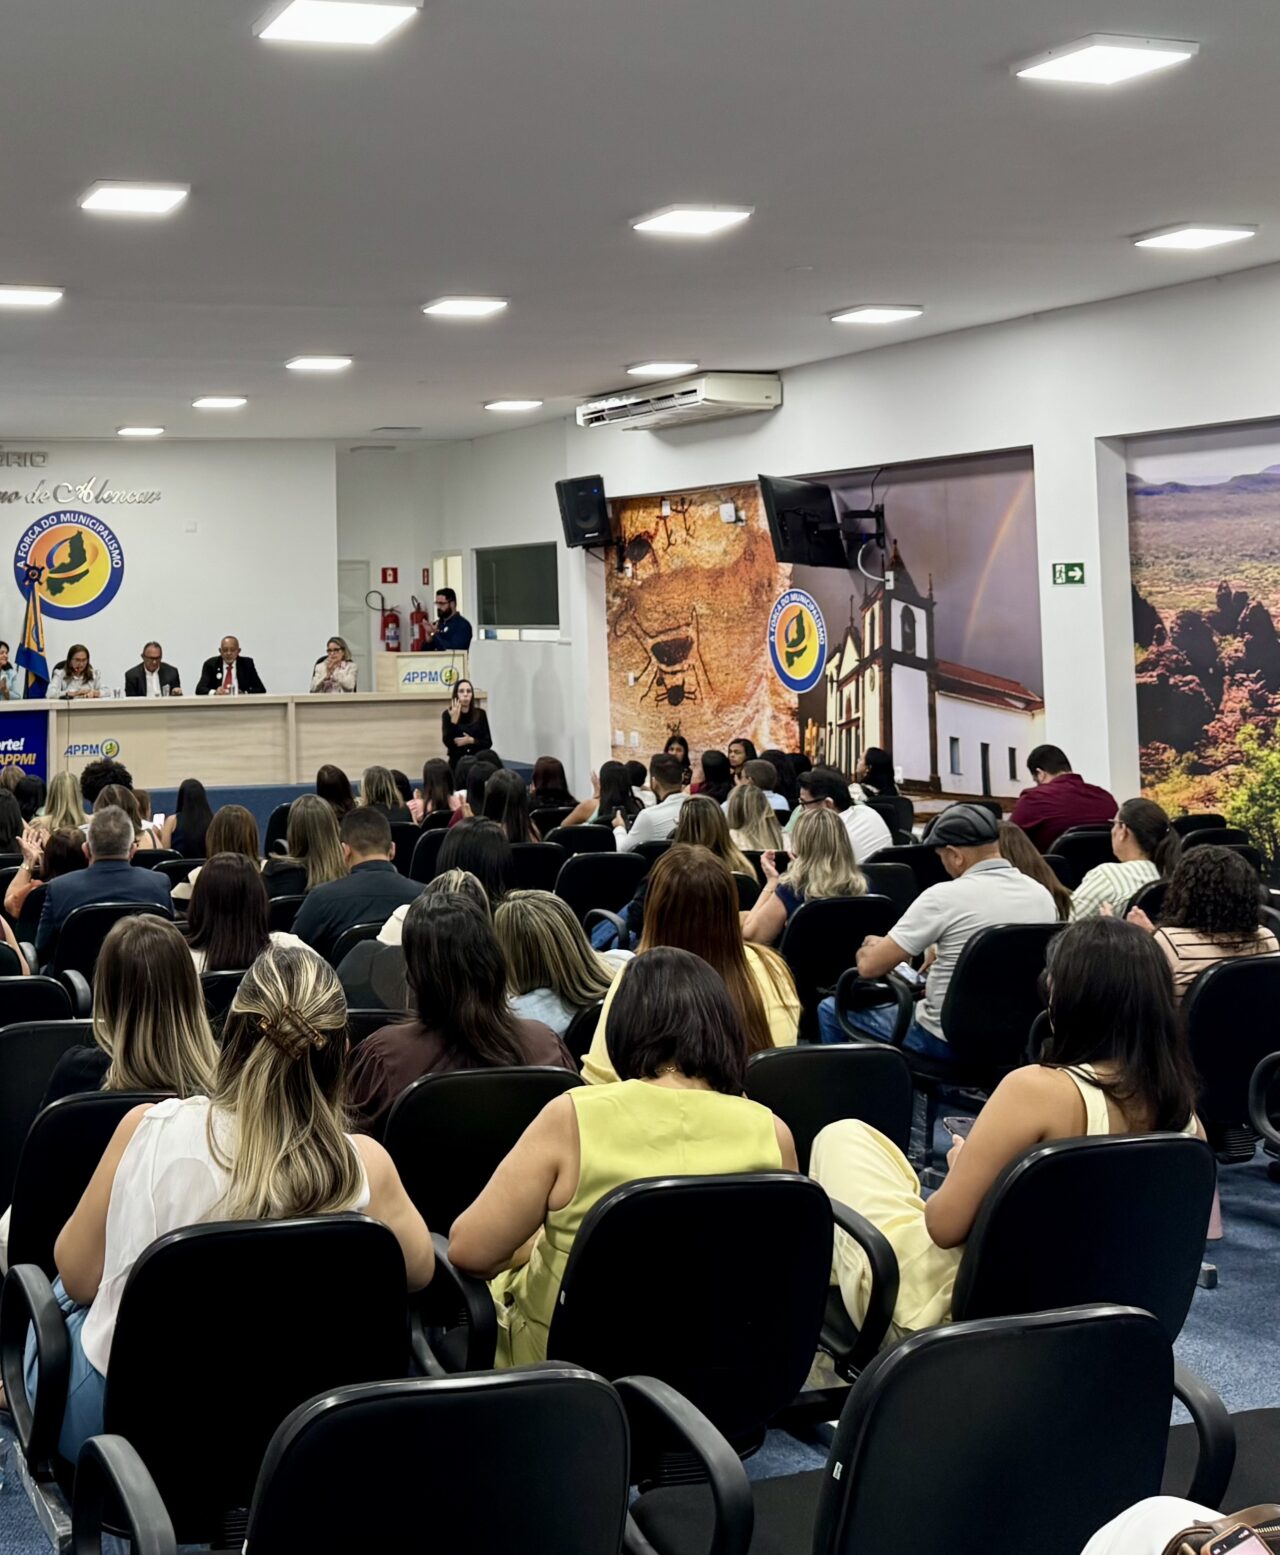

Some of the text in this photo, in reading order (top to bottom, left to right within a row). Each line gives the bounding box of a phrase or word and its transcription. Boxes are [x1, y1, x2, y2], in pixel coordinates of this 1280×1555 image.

[24, 480, 51, 504] de
[16, 560, 27, 569] A
[40, 515, 57, 529] DO
[60, 512, 122, 568] MUNICIPALISMO
[402, 670, 439, 683] APPM
[64, 744, 99, 756] APPM
